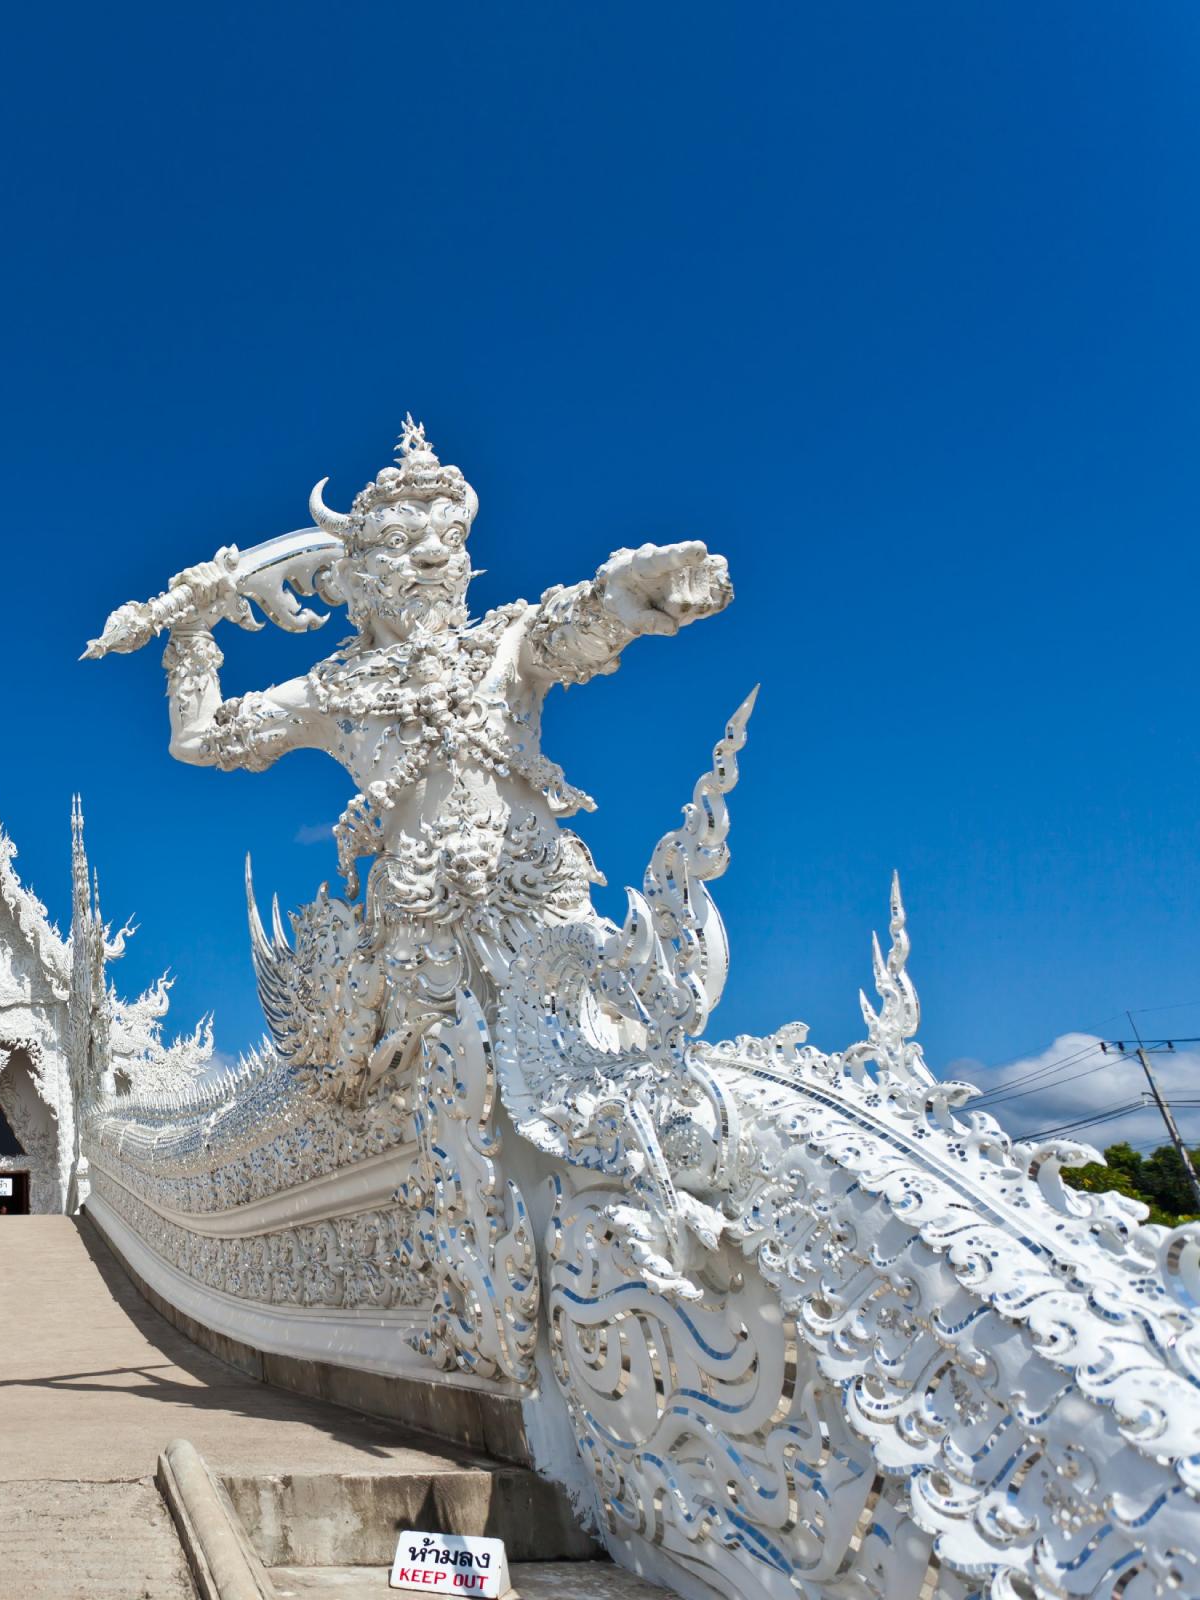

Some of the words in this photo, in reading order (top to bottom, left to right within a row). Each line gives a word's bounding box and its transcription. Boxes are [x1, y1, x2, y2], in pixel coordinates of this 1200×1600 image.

[408, 1537, 491, 1569] ห้ามลง
[399, 1567, 447, 1585] KEEP
[453, 1573, 489, 1590] OUT
